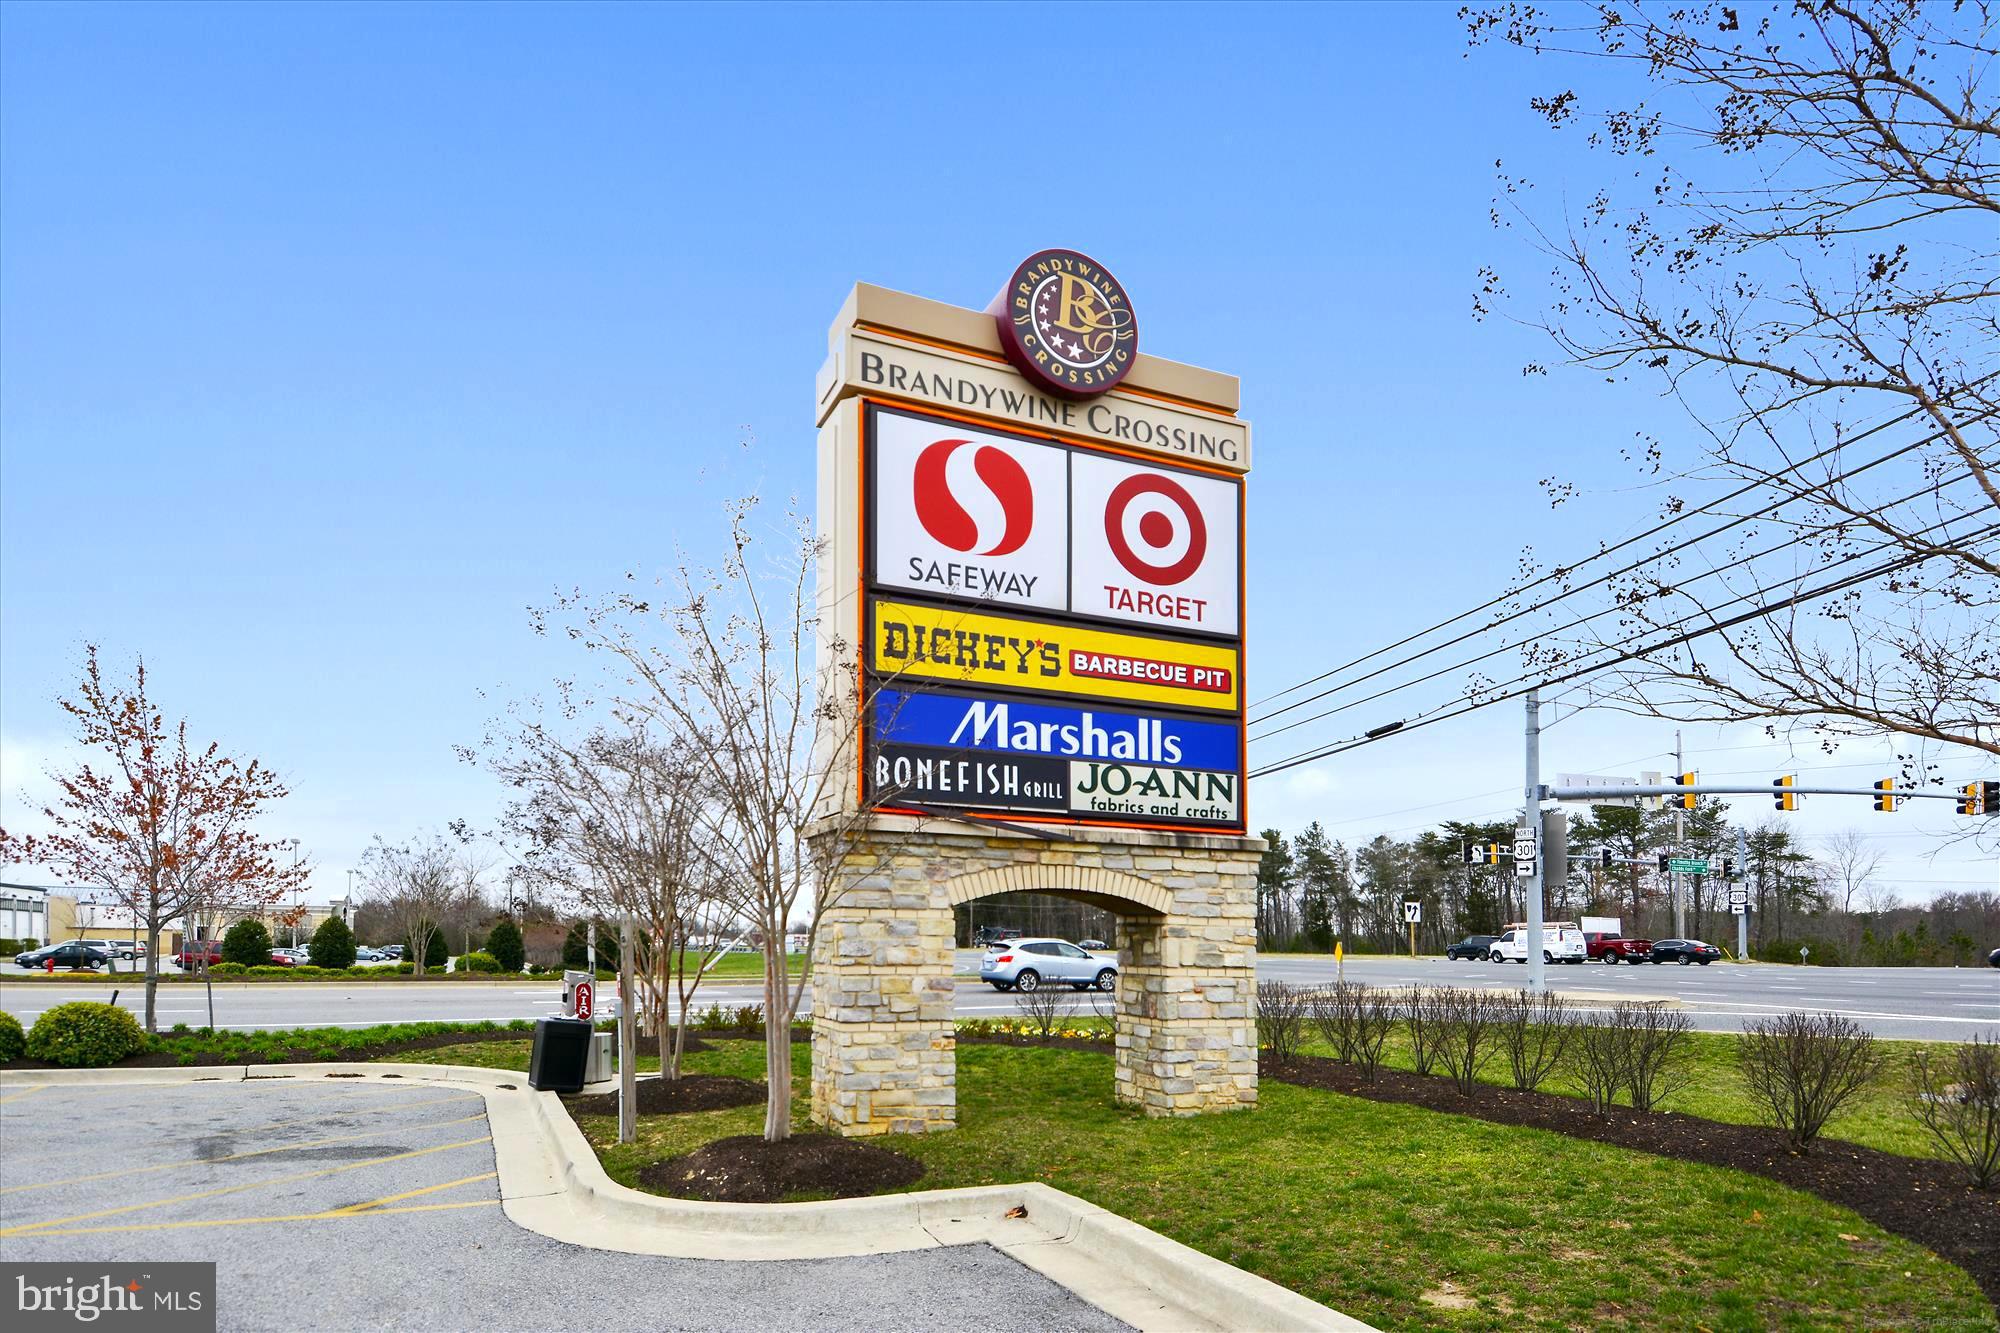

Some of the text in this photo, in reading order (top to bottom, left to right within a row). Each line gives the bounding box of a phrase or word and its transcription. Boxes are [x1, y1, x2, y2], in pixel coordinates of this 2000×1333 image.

[1016, 258, 1121, 309] BRANDYWINE
[1023, 333, 1128, 384] CROSSING
[861, 351, 1239, 462] BRANDYWINE CROSSING
[909, 557, 1038, 598] SAFEWAY
[1104, 585, 1208, 622] TARGET
[1073, 653, 1226, 688] BARBECUE PIT
[949, 701, 1183, 764] Marshalls
[875, 755, 1063, 799] BONEFISH GRILL
[1090, 796, 1228, 819] fabrics and crafts
[1515, 829, 1535, 837] NORTH
[1517, 844, 1533, 856] 301
[1732, 893, 1745, 902] 301
[578, 987, 590, 1014] AIR
